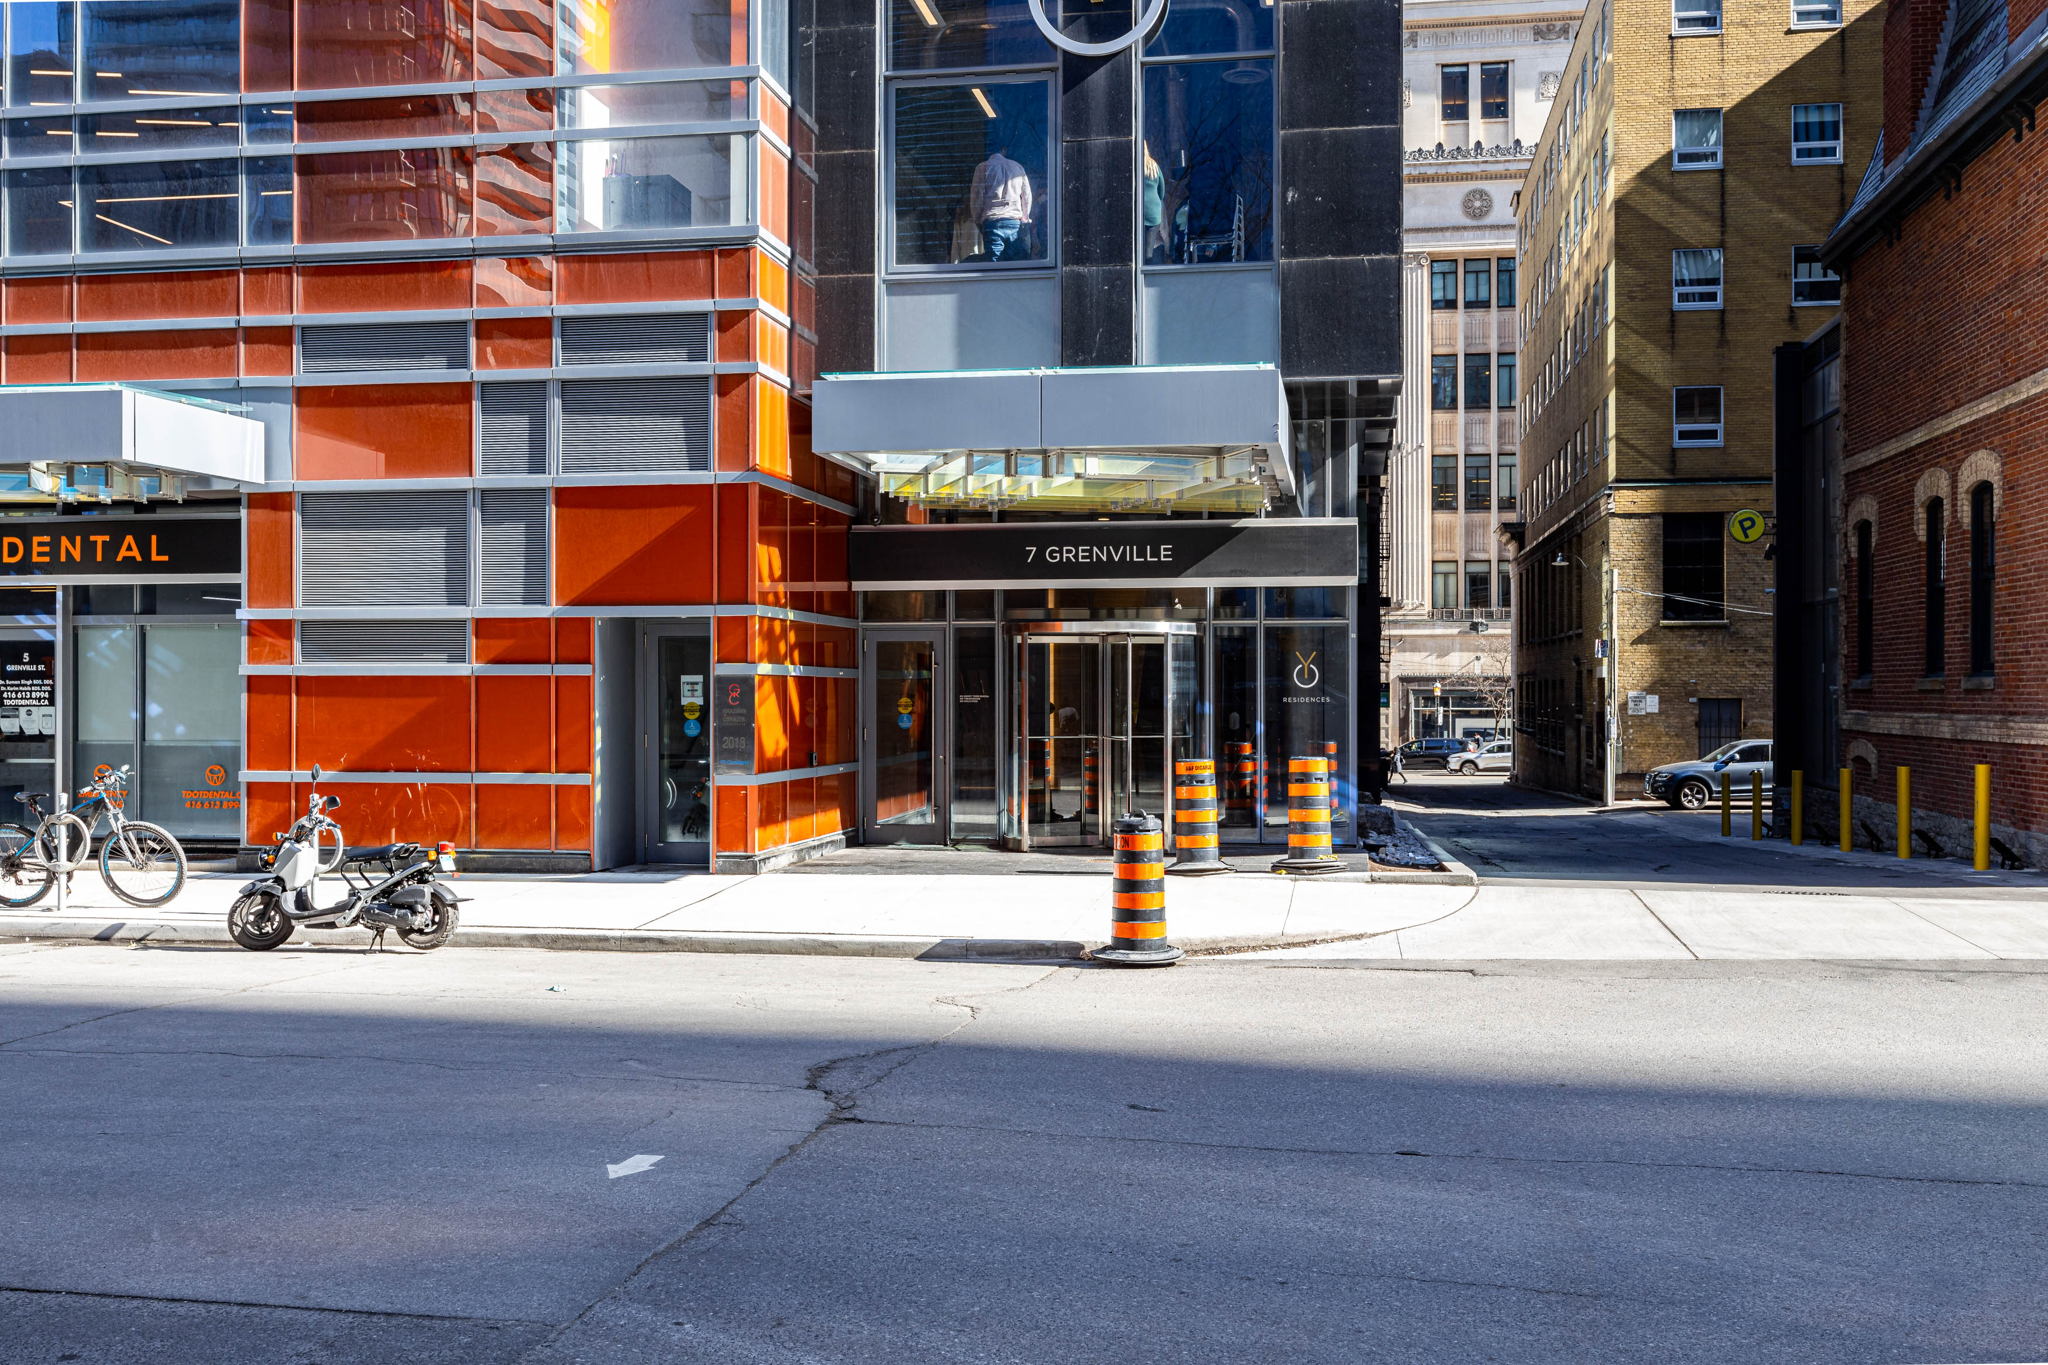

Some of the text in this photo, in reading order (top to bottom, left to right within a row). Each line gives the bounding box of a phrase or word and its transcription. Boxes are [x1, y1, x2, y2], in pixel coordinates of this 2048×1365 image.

[1738, 516, 1756, 539] P
[2, 535, 169, 563] DENTAL
[1025, 545, 1173, 563] 7 GRENVILLE
[22, 652, 30, 662] 5
[181, 790, 241, 799] TDOTDENTAL.C
